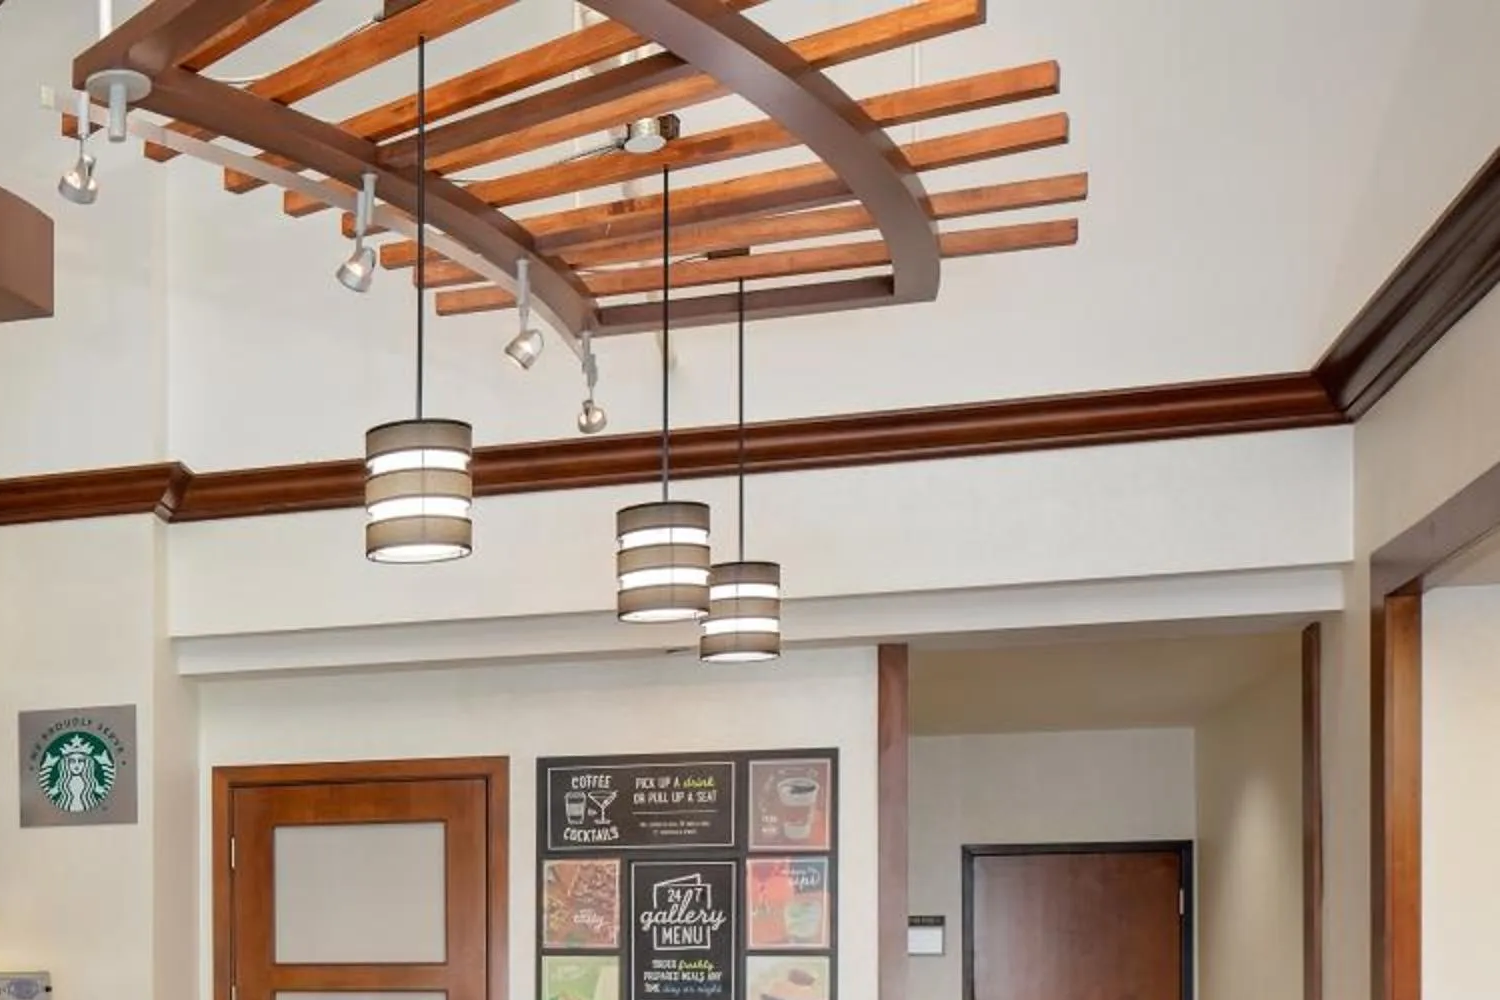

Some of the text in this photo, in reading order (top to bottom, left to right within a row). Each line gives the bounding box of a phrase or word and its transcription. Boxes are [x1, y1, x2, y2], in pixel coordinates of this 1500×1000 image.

[571, 774, 612, 789] COFFEE
[635, 777, 656, 789] PICK
[658, 776, 671, 788] UP
[673, 776, 681, 788] A
[633, 789, 717, 805] OR PULL UP A SEAT
[563, 826, 620, 842] COCKTAILS
[640, 888, 727, 932] gallery
[662, 925, 703, 945] MENU
